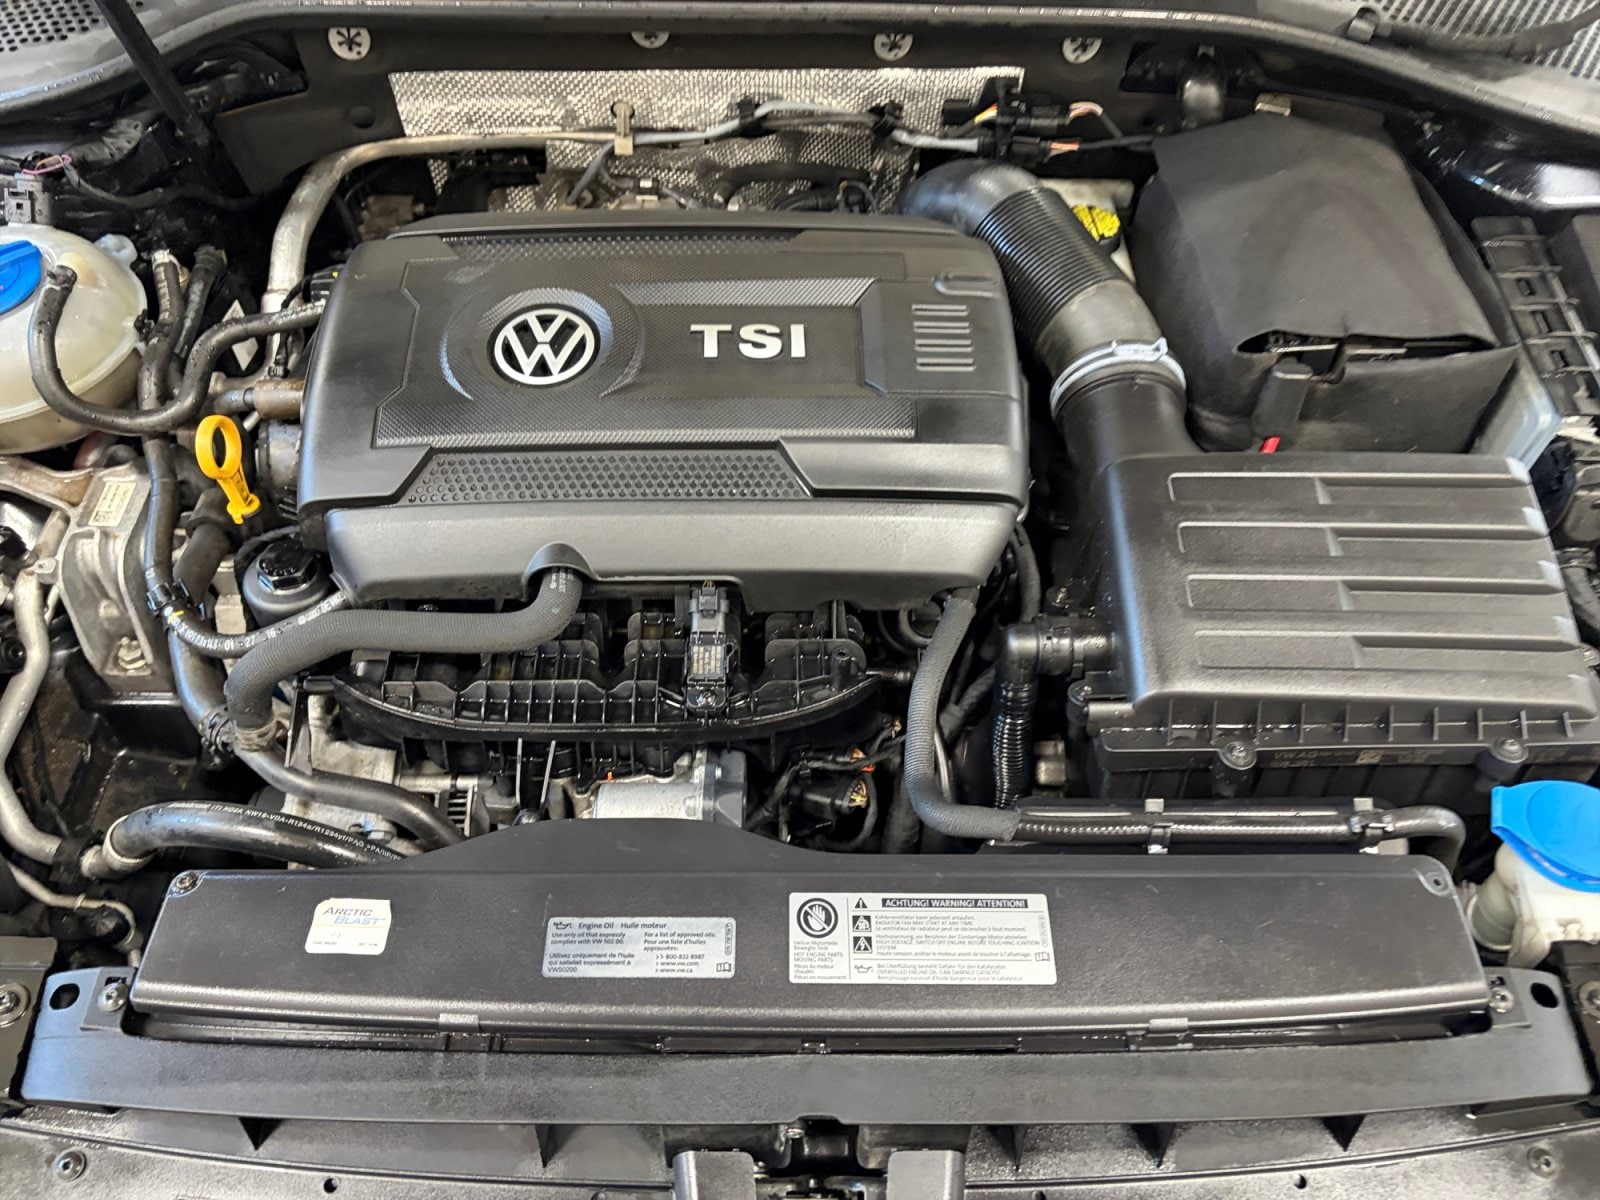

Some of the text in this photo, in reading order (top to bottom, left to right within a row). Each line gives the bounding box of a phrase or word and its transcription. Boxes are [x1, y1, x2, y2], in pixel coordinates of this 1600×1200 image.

[690, 323, 806, 358] TSI
[885, 899, 1026, 907] ACHTUNG! WARNING! ATTENTION!
[578, 922, 667, 930] Engine Oil Huile moteur
